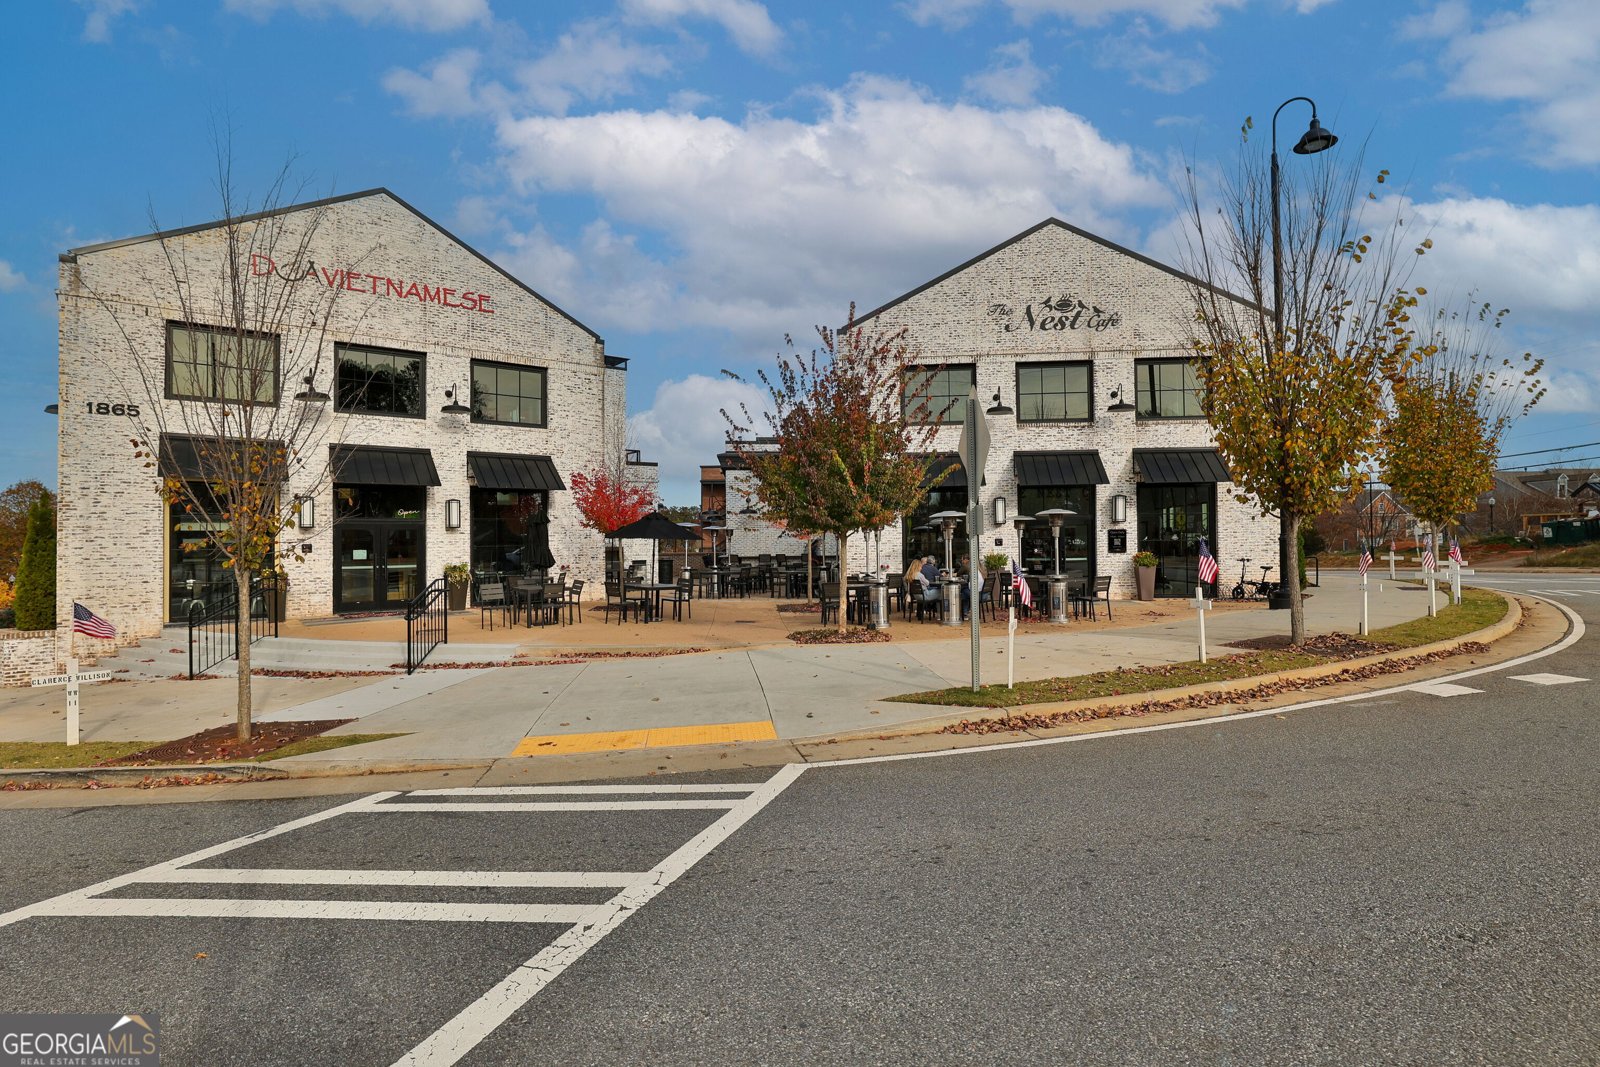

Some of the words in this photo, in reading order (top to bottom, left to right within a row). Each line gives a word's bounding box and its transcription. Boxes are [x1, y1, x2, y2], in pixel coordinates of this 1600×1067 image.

[322, 267, 494, 314] VIETNAMESE
[987, 303, 1014, 316] The
[1004, 304, 1086, 332] Nest
[86, 401, 140, 417] 1865
[397, 508, 420, 519] Open
